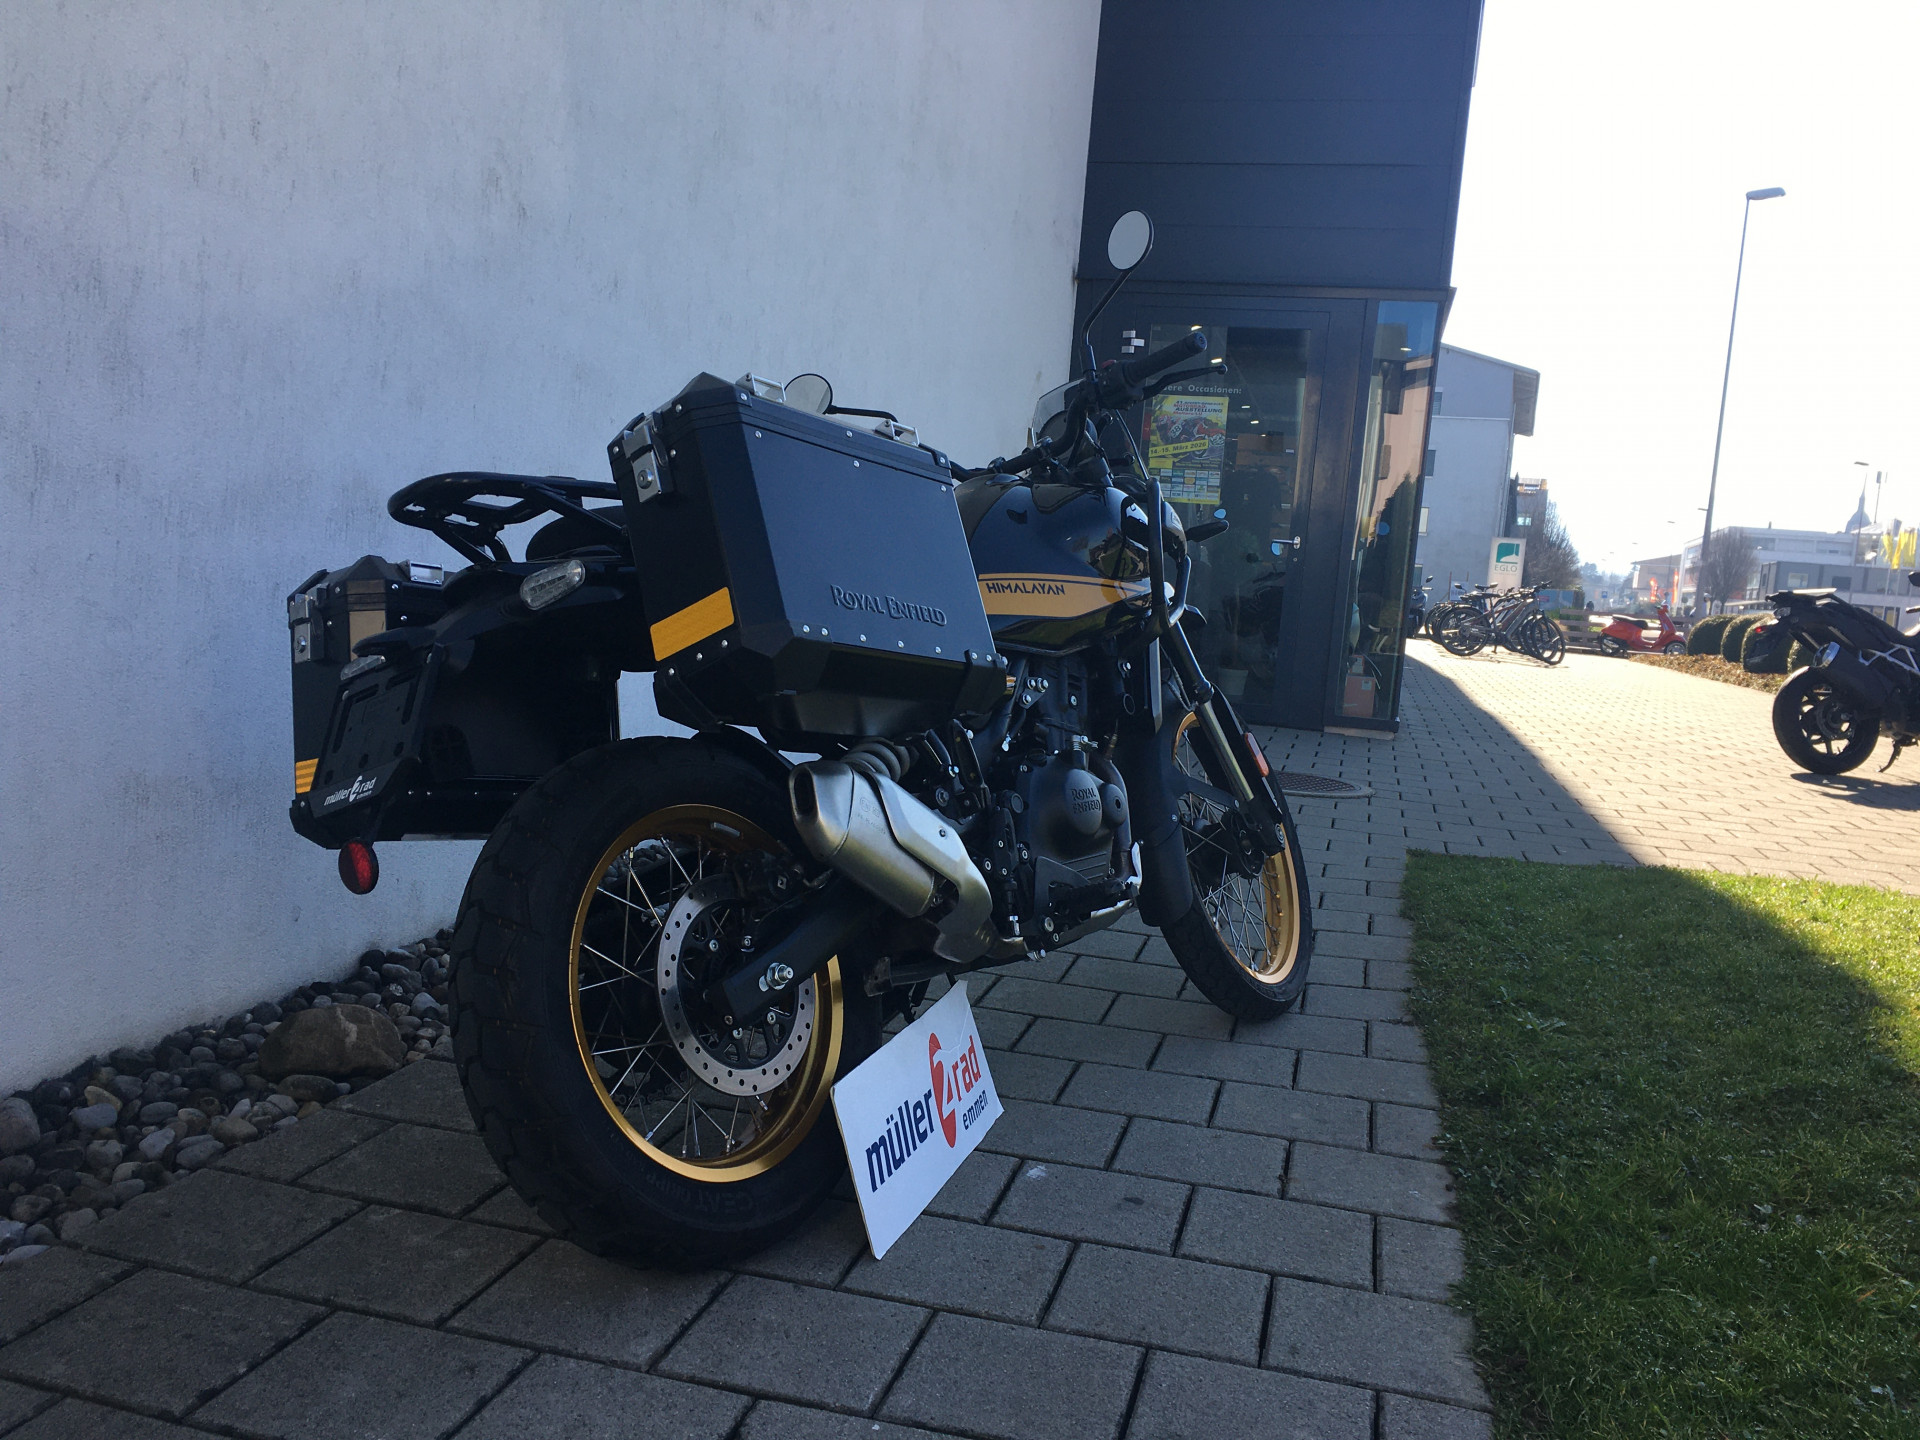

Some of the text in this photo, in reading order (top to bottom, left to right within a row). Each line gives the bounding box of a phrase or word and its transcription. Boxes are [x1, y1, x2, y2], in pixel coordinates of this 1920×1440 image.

[1188, 384, 1242, 394] Occasionen:
[1190, 442, 1207, 450] 2026
[1494, 564, 1518, 573] EGLO
[985, 582, 1066, 596] HIMALAYAN
[962, 1089, 988, 1131] emmen
[865, 1089, 935, 1193] müller
